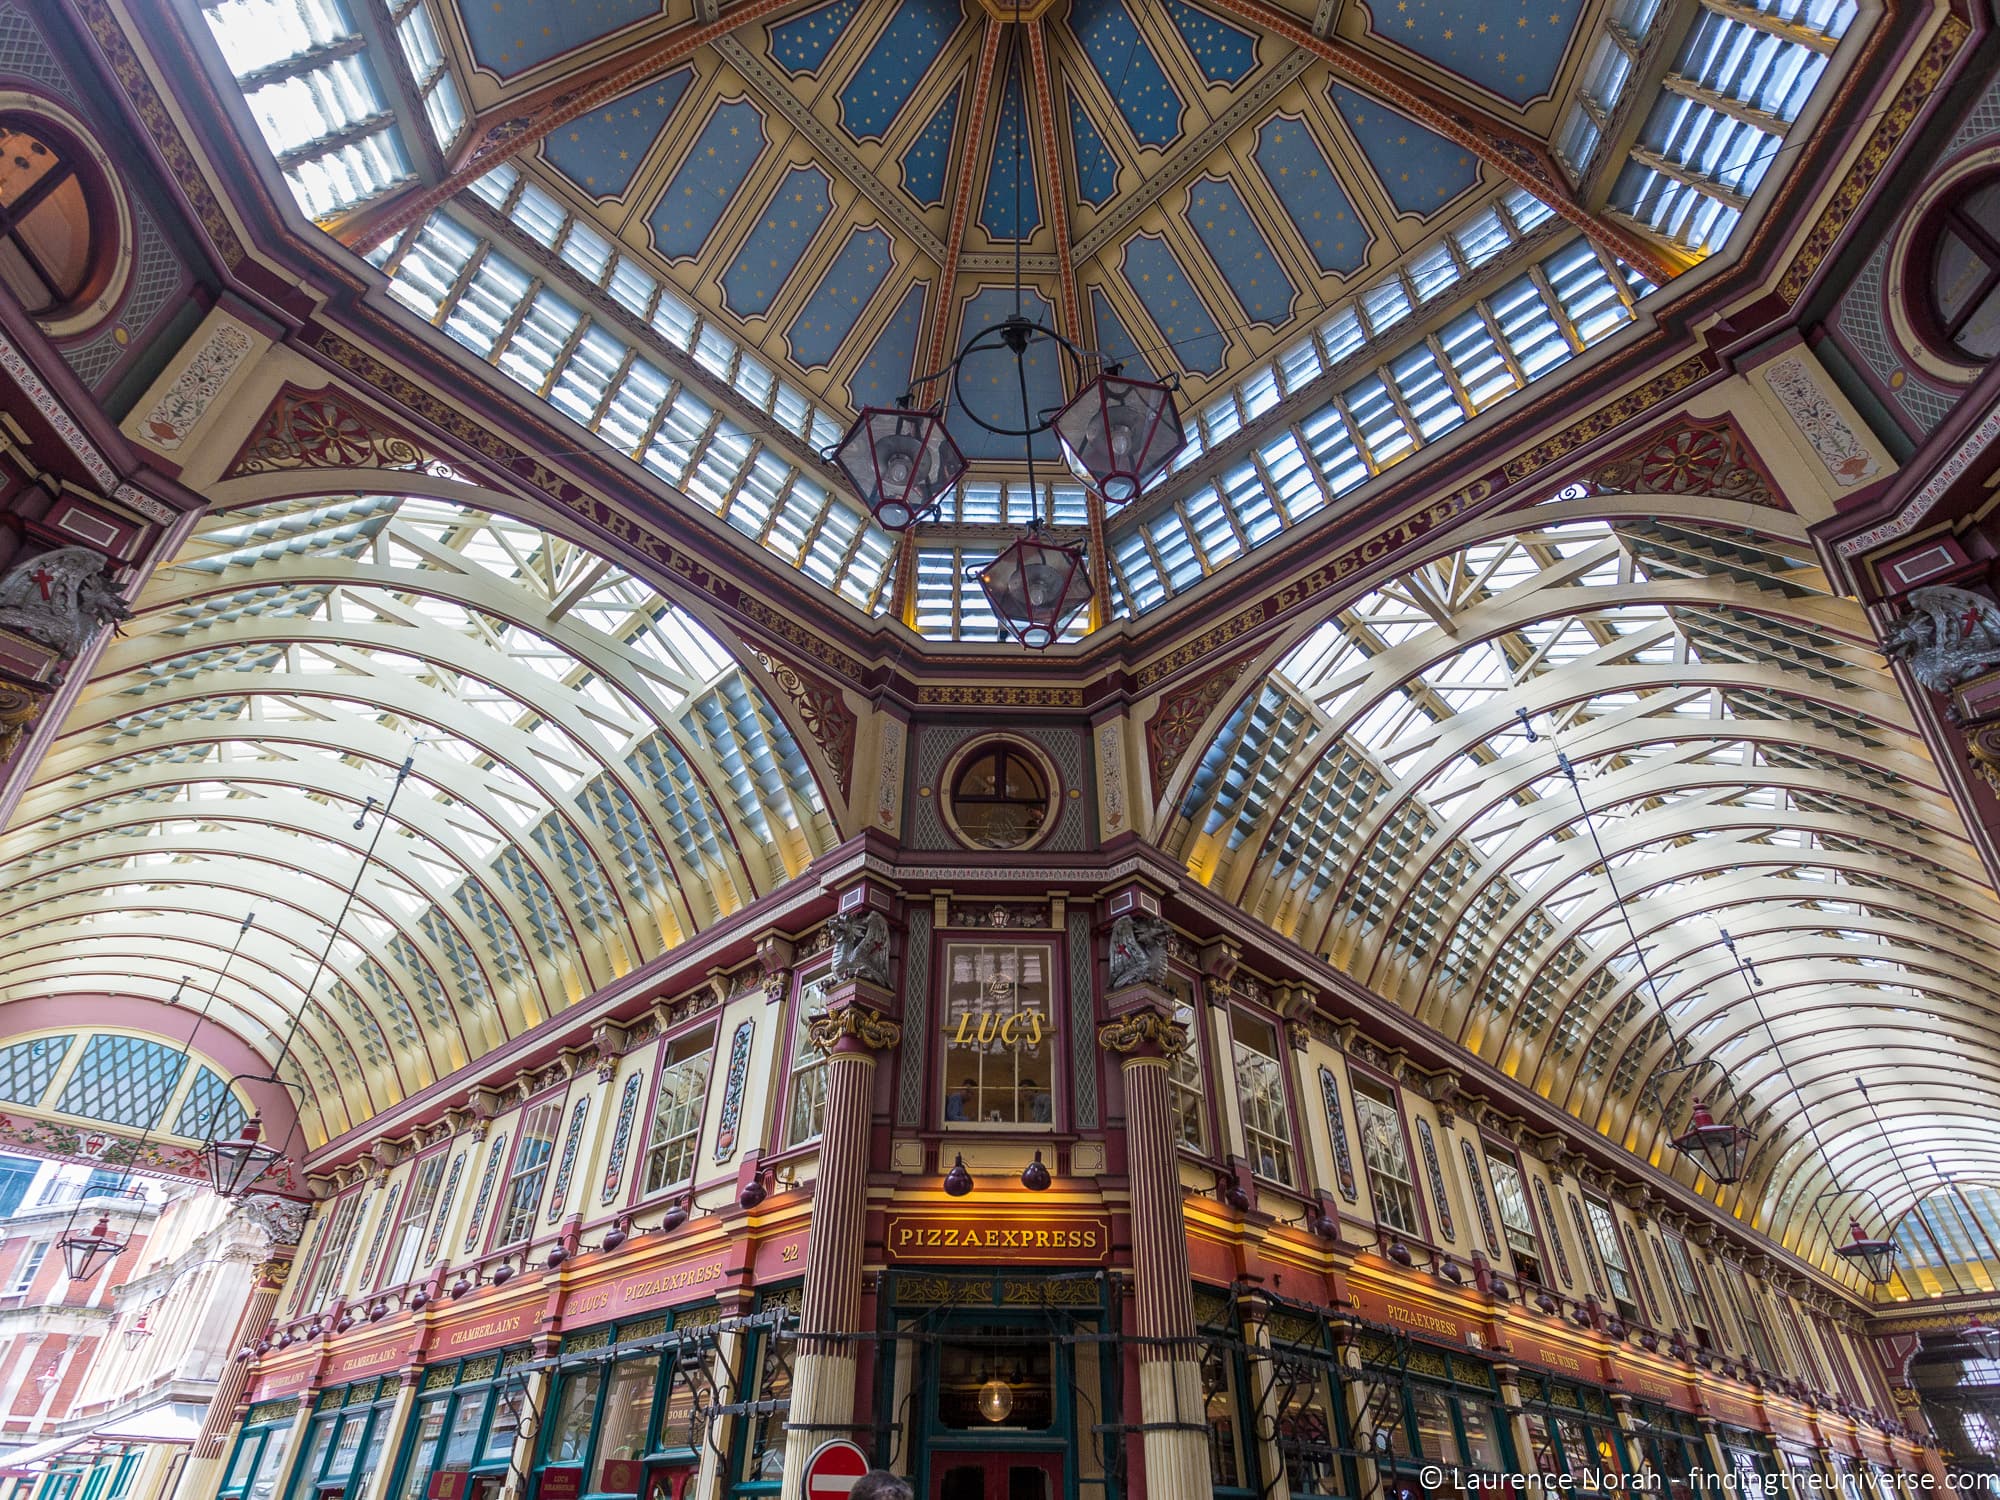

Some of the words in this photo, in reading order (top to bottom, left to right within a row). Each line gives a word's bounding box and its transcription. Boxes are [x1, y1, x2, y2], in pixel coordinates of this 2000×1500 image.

[527, 461, 727, 595] MARKET
[1275, 479, 1493, 613] ERECTED
[954, 1008, 1046, 1044] LUC'S
[783, 1243, 798, 1262] 22
[900, 1229, 1097, 1248] PIZZAEXPRESS
[624, 1263, 722, 1302] PIZZAEXPRESS
[579, 1290, 609, 1313] LUC'S
[451, 1316, 521, 1345] CHAMBERLAIN'S
[1387, 1304, 1457, 1337] PIZZAEXPRESS
[1540, 1349, 1558, 1365] FINE
[1557, 1354, 1580, 1371] WINES
